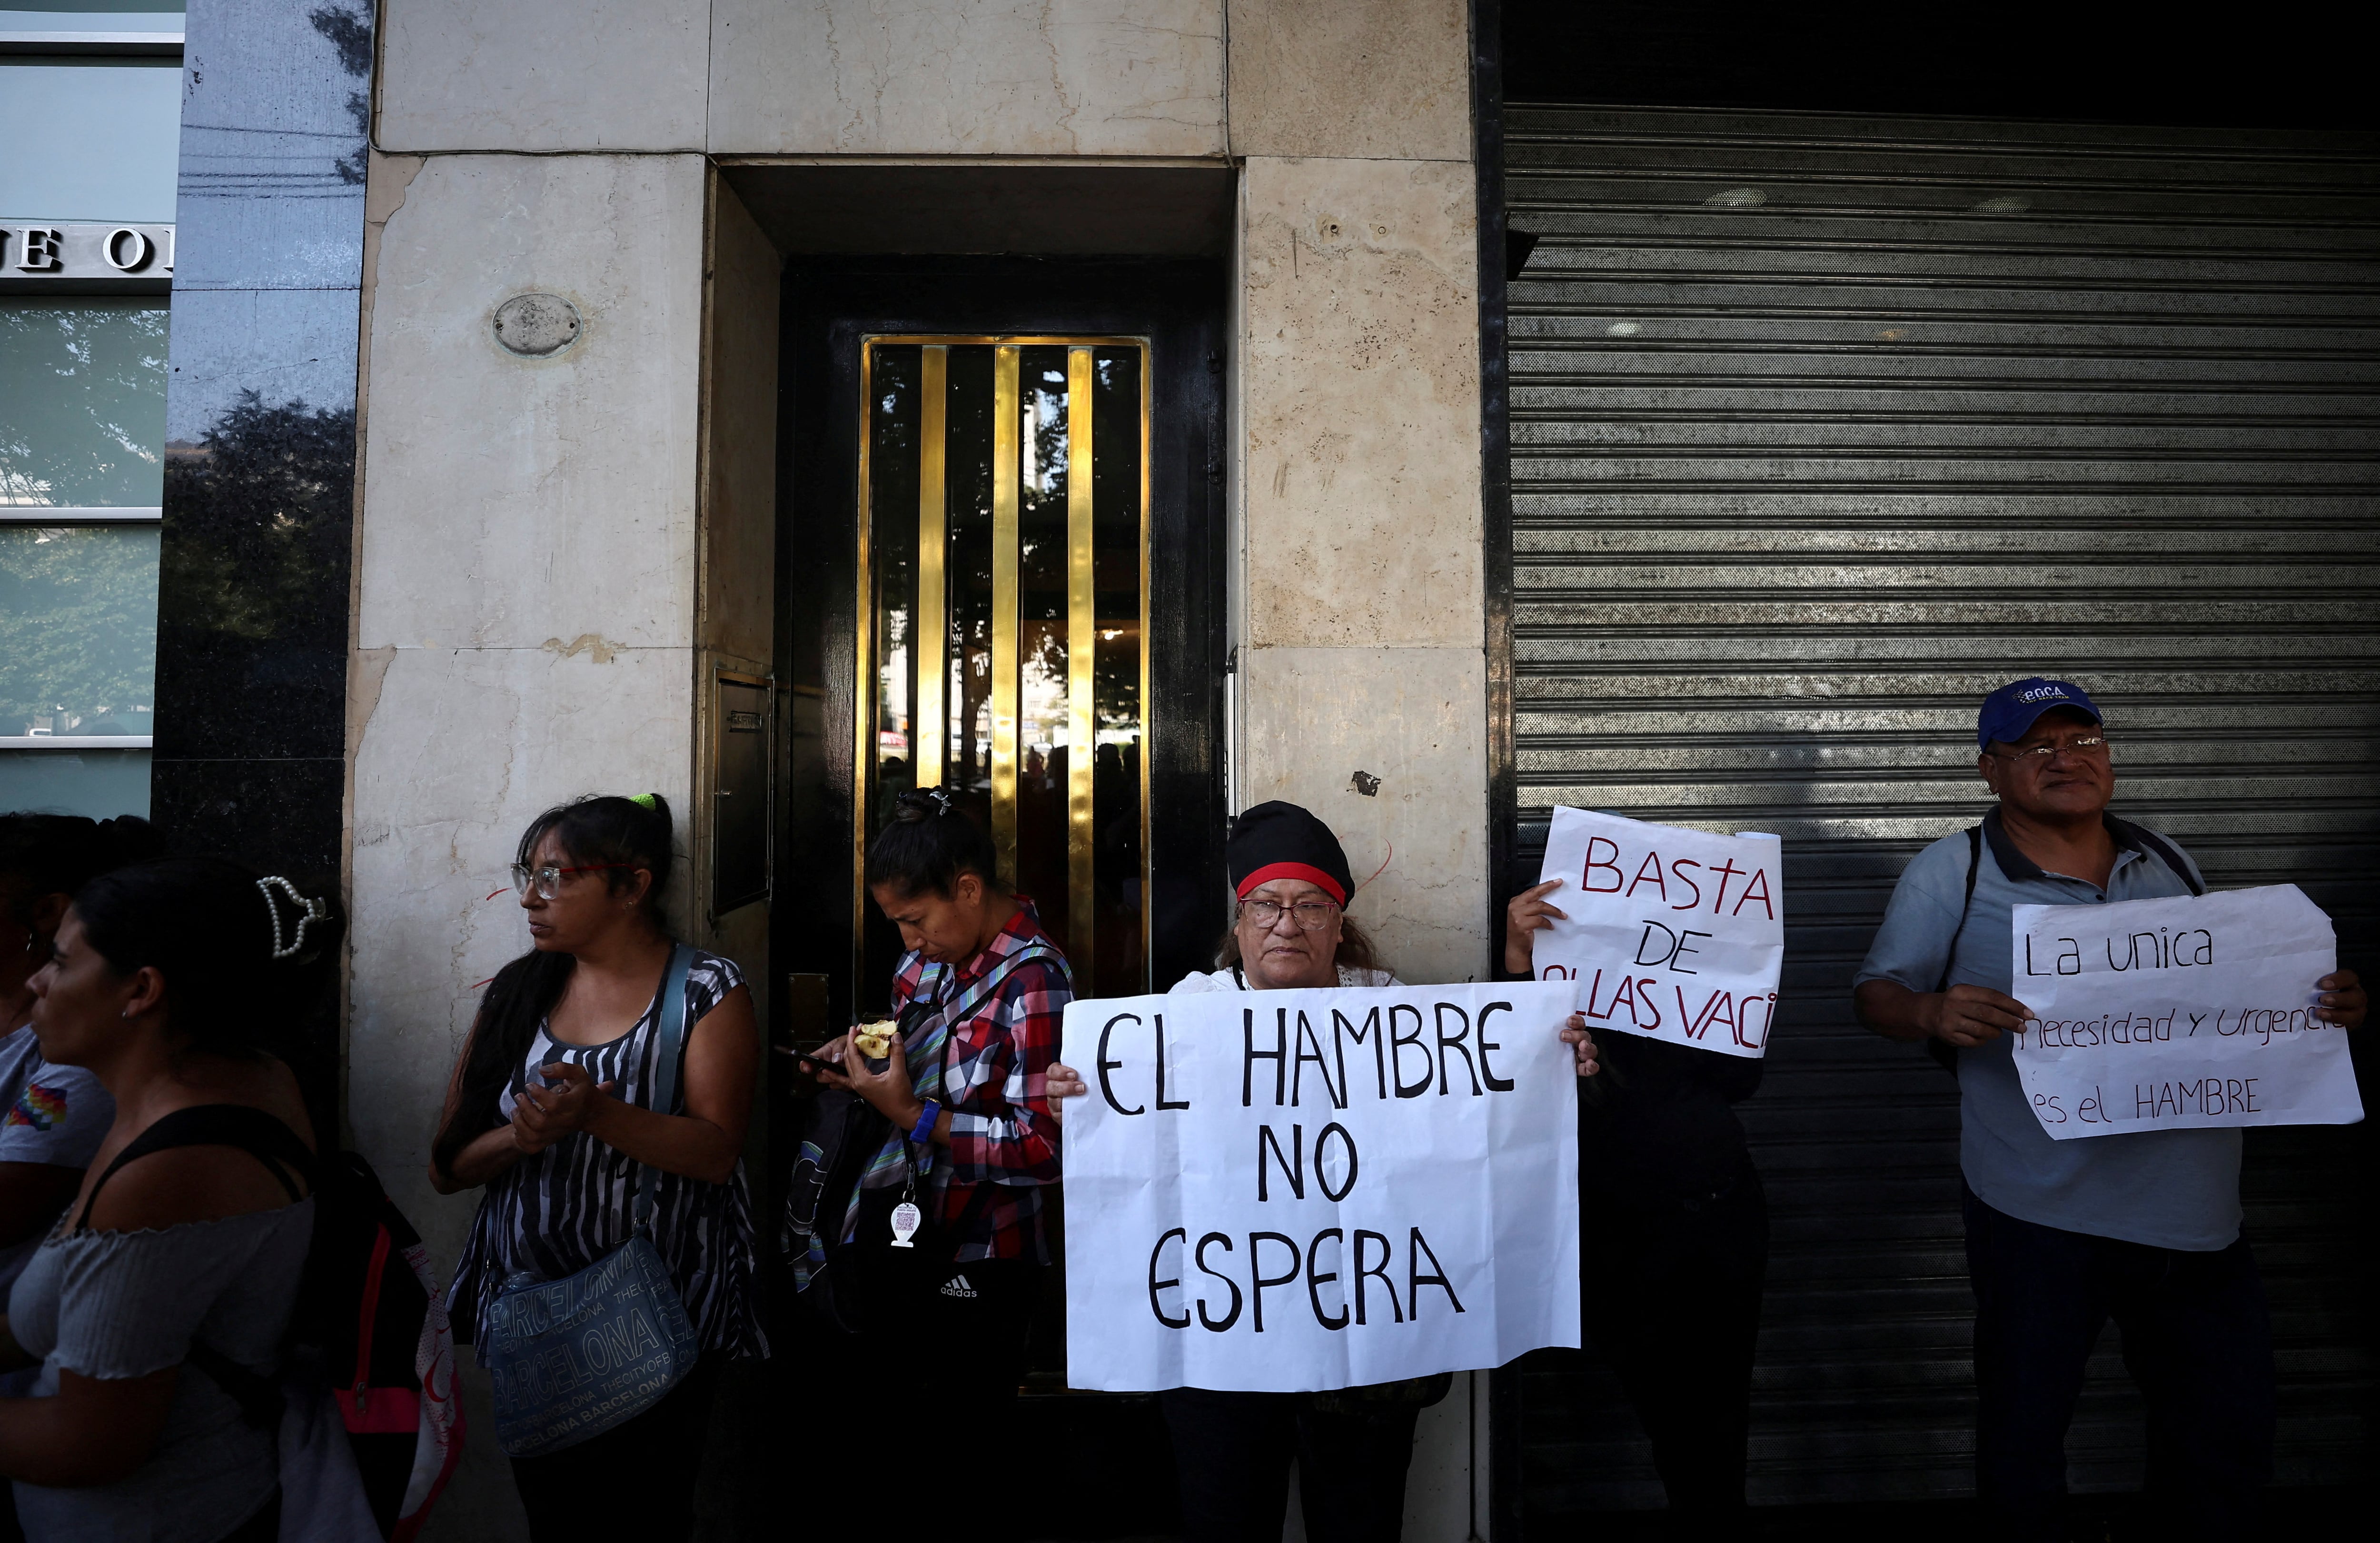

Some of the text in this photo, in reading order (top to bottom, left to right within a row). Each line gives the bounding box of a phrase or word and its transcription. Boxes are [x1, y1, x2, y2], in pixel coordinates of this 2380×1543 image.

[1634, 920, 1712, 975] DE
[2027, 934, 2080, 976] La
[2021, 1008, 2175, 1050] necesidad
[1097, 1002, 1514, 1115] EL HAMBRE
[2034, 1078, 2261, 1123] es el HAMBRE
[1258, 1122, 1358, 1202] NO
[941, 1286, 977, 1297] adidas
[1149, 1227, 1466, 1333] ESPERA
[493, 1307, 660, 1416] BARCELONA
[582, 1374, 668, 1422] BARCELONA
